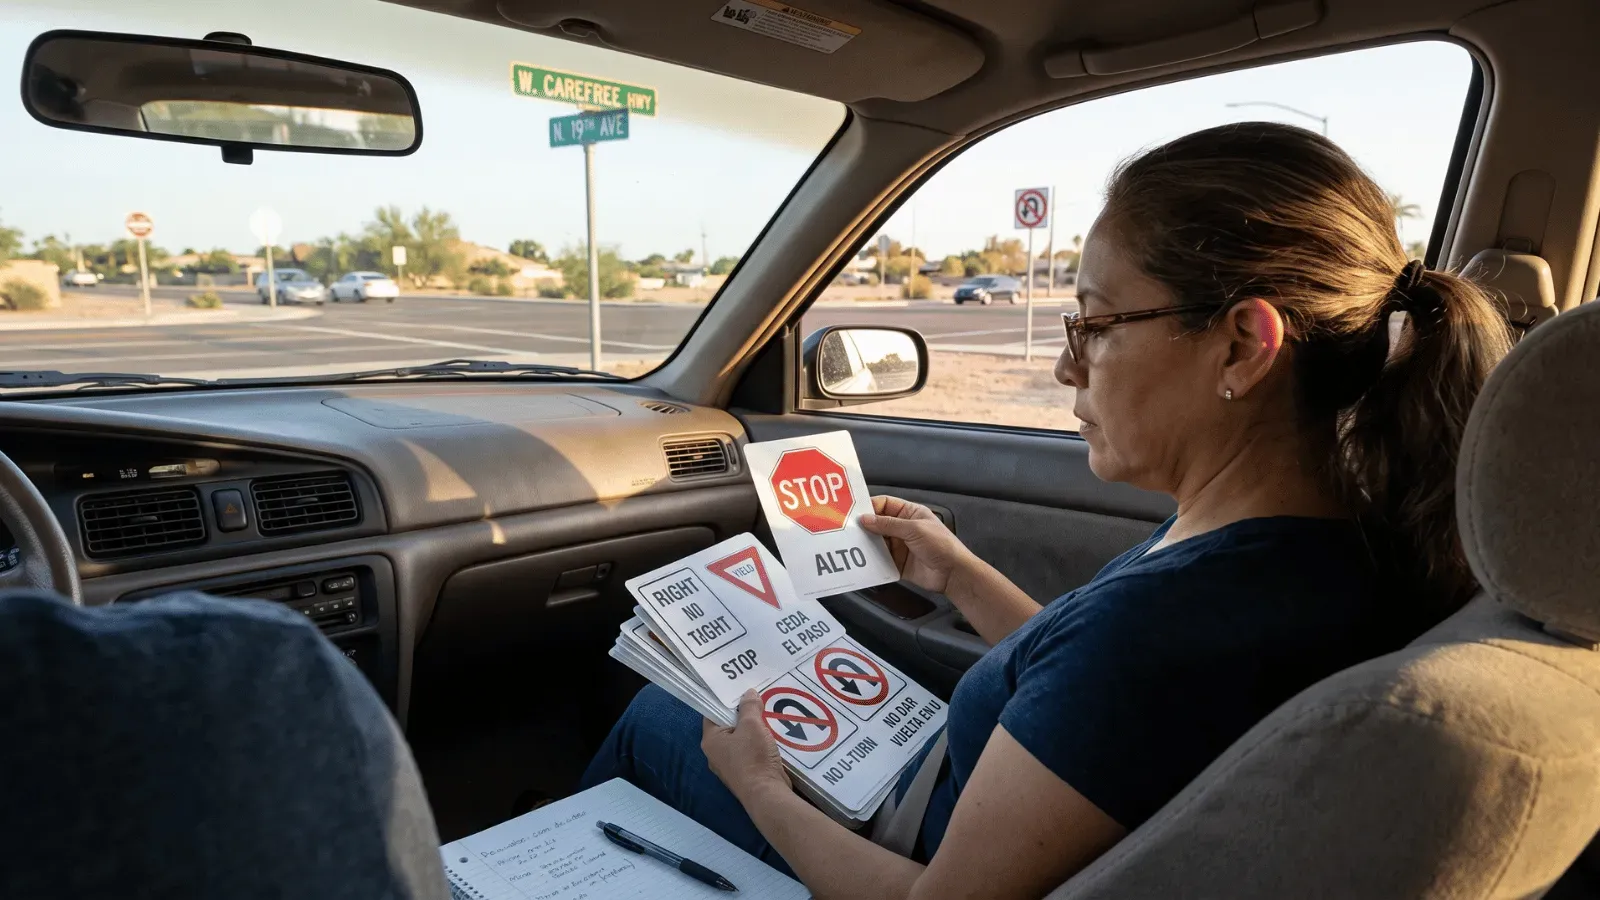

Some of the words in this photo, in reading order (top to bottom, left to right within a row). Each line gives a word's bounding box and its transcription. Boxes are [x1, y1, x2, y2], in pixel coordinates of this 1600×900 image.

[518, 70, 537, 94] W.
[543, 74, 621, 107] CAREFREE
[627, 92, 652, 111] HWY
[600, 113, 624, 137] AVE
[779, 472, 844, 510] STOP
[732, 563, 755, 580] YIELD
[815, 546, 867, 577] ALTO
[652, 576, 700, 608] RIGHT
[681, 602, 705, 622] NO
[775, 610, 811, 635] CEDA
[781, 637, 803, 656] EL
[799, 620, 831, 648] PASO
[720, 649, 759, 681] STOP
[882, 711, 900, 729] NO
[899, 696, 919, 717] DAR
[889, 715, 926, 748] VUELTA
[919, 706, 937, 722] EN
[931, 699, 942, 712] U
[822, 766, 844, 786] NO
[840, 736, 879, 772] U-TURN
